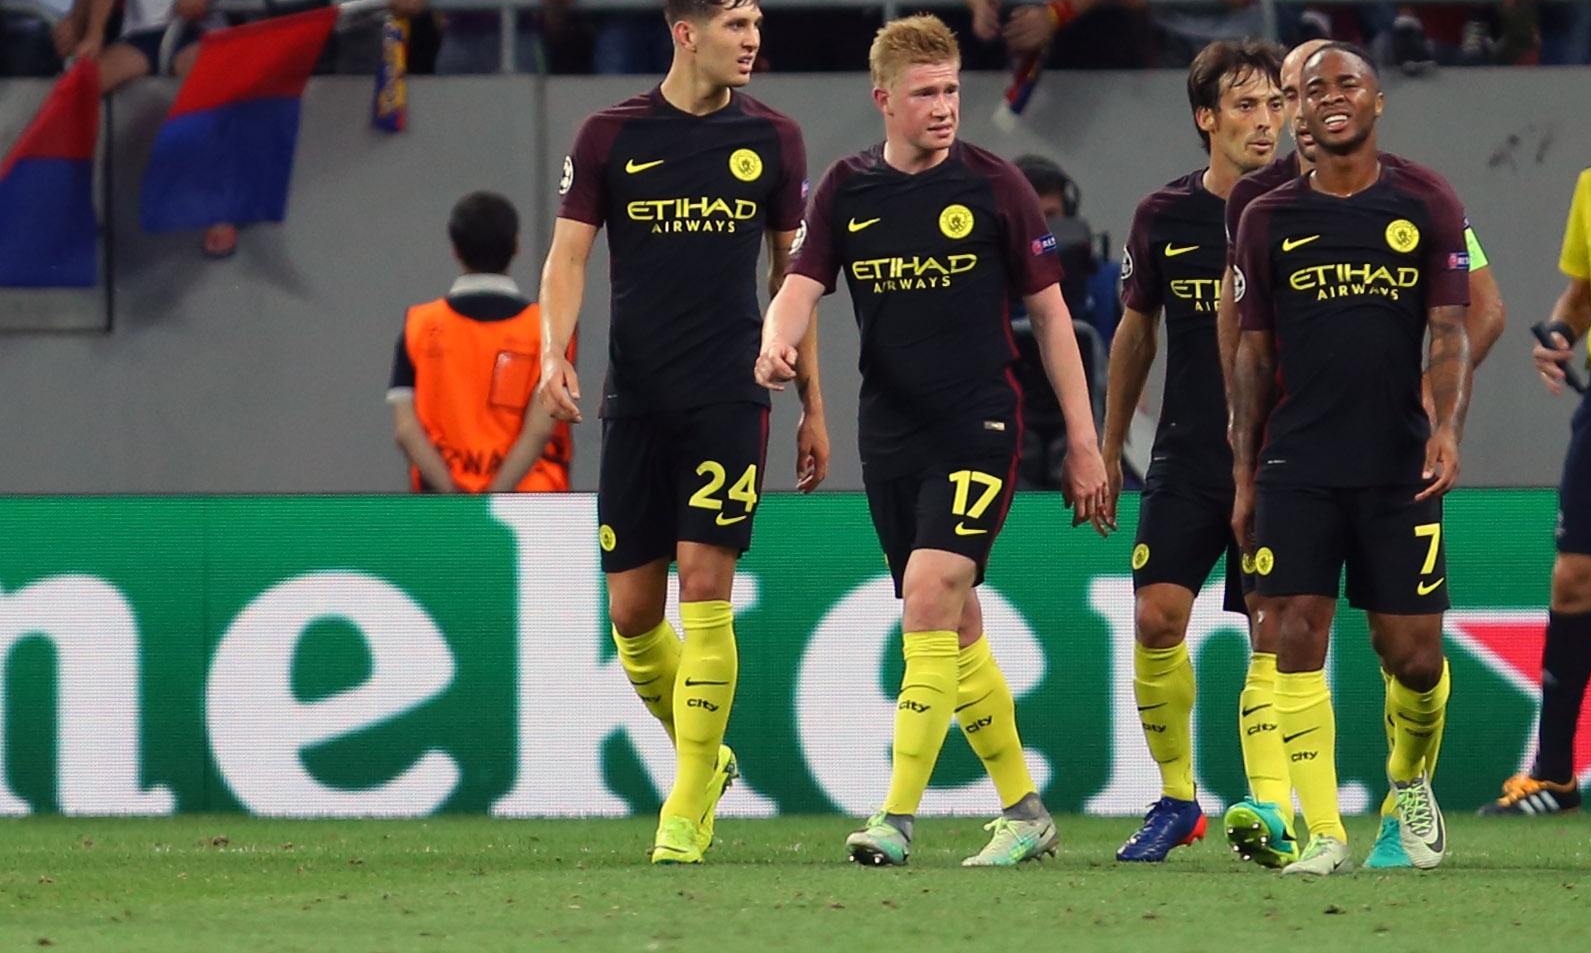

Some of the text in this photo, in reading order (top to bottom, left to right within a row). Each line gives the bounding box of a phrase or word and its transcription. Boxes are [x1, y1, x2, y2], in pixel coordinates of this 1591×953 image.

[627, 197, 757, 220] ETIHAD
[651, 220, 736, 234] AIRWAYS
[852, 253, 978, 280] ETIHAD
[1289, 263, 1419, 290] ETIHAD
[873, 275, 951, 294] AIRWAYS
[1170, 279, 1222, 299] ETI
[1317, 284, 1400, 301] AIRWAYS
[688, 460, 758, 512] 24
[948, 469, 1003, 518] 17
[1414, 523, 1441, 575] 7
[687, 699, 719, 712] city
[899, 700, 931, 713] city
[1291, 751, 1318, 762] city
